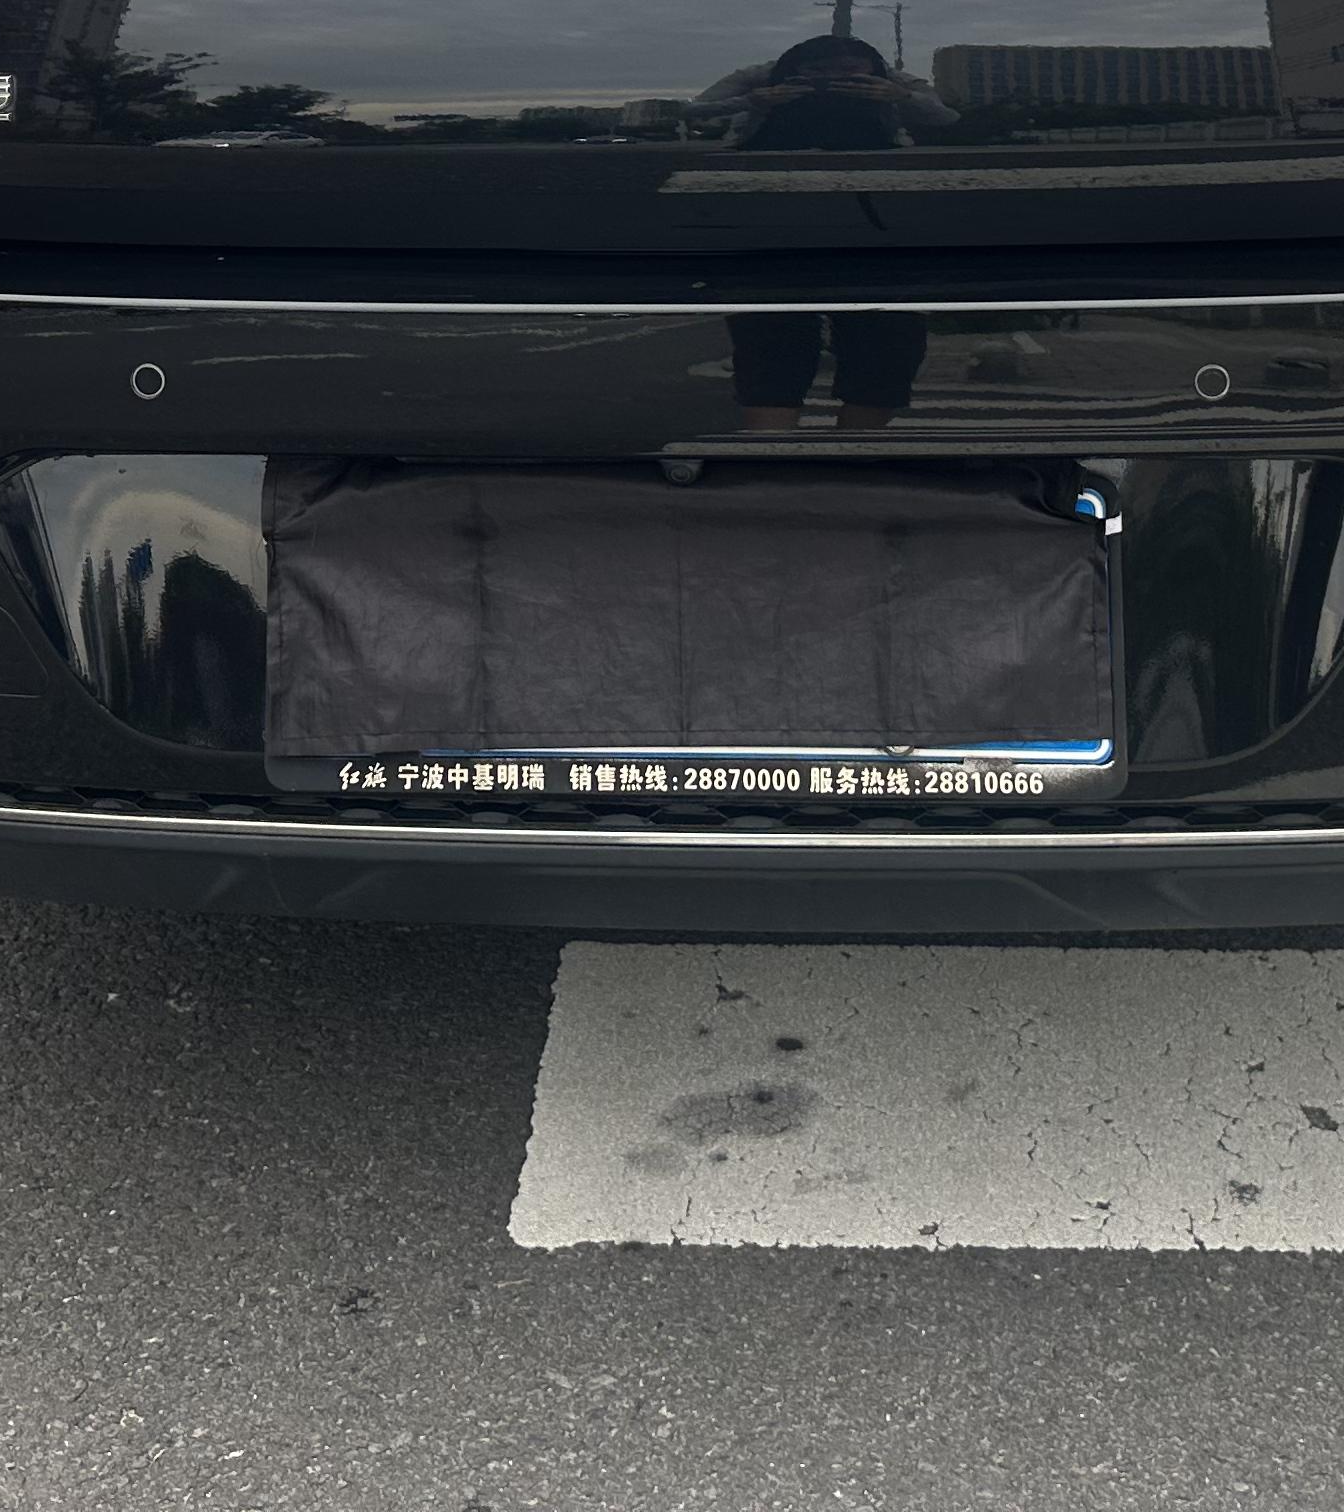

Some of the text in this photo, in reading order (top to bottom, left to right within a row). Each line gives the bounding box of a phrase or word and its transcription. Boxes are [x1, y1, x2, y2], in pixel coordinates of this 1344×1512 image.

[339, 761, 387, 791] 红旗
[398, 762, 546, 792] 宁波中基明瑞
